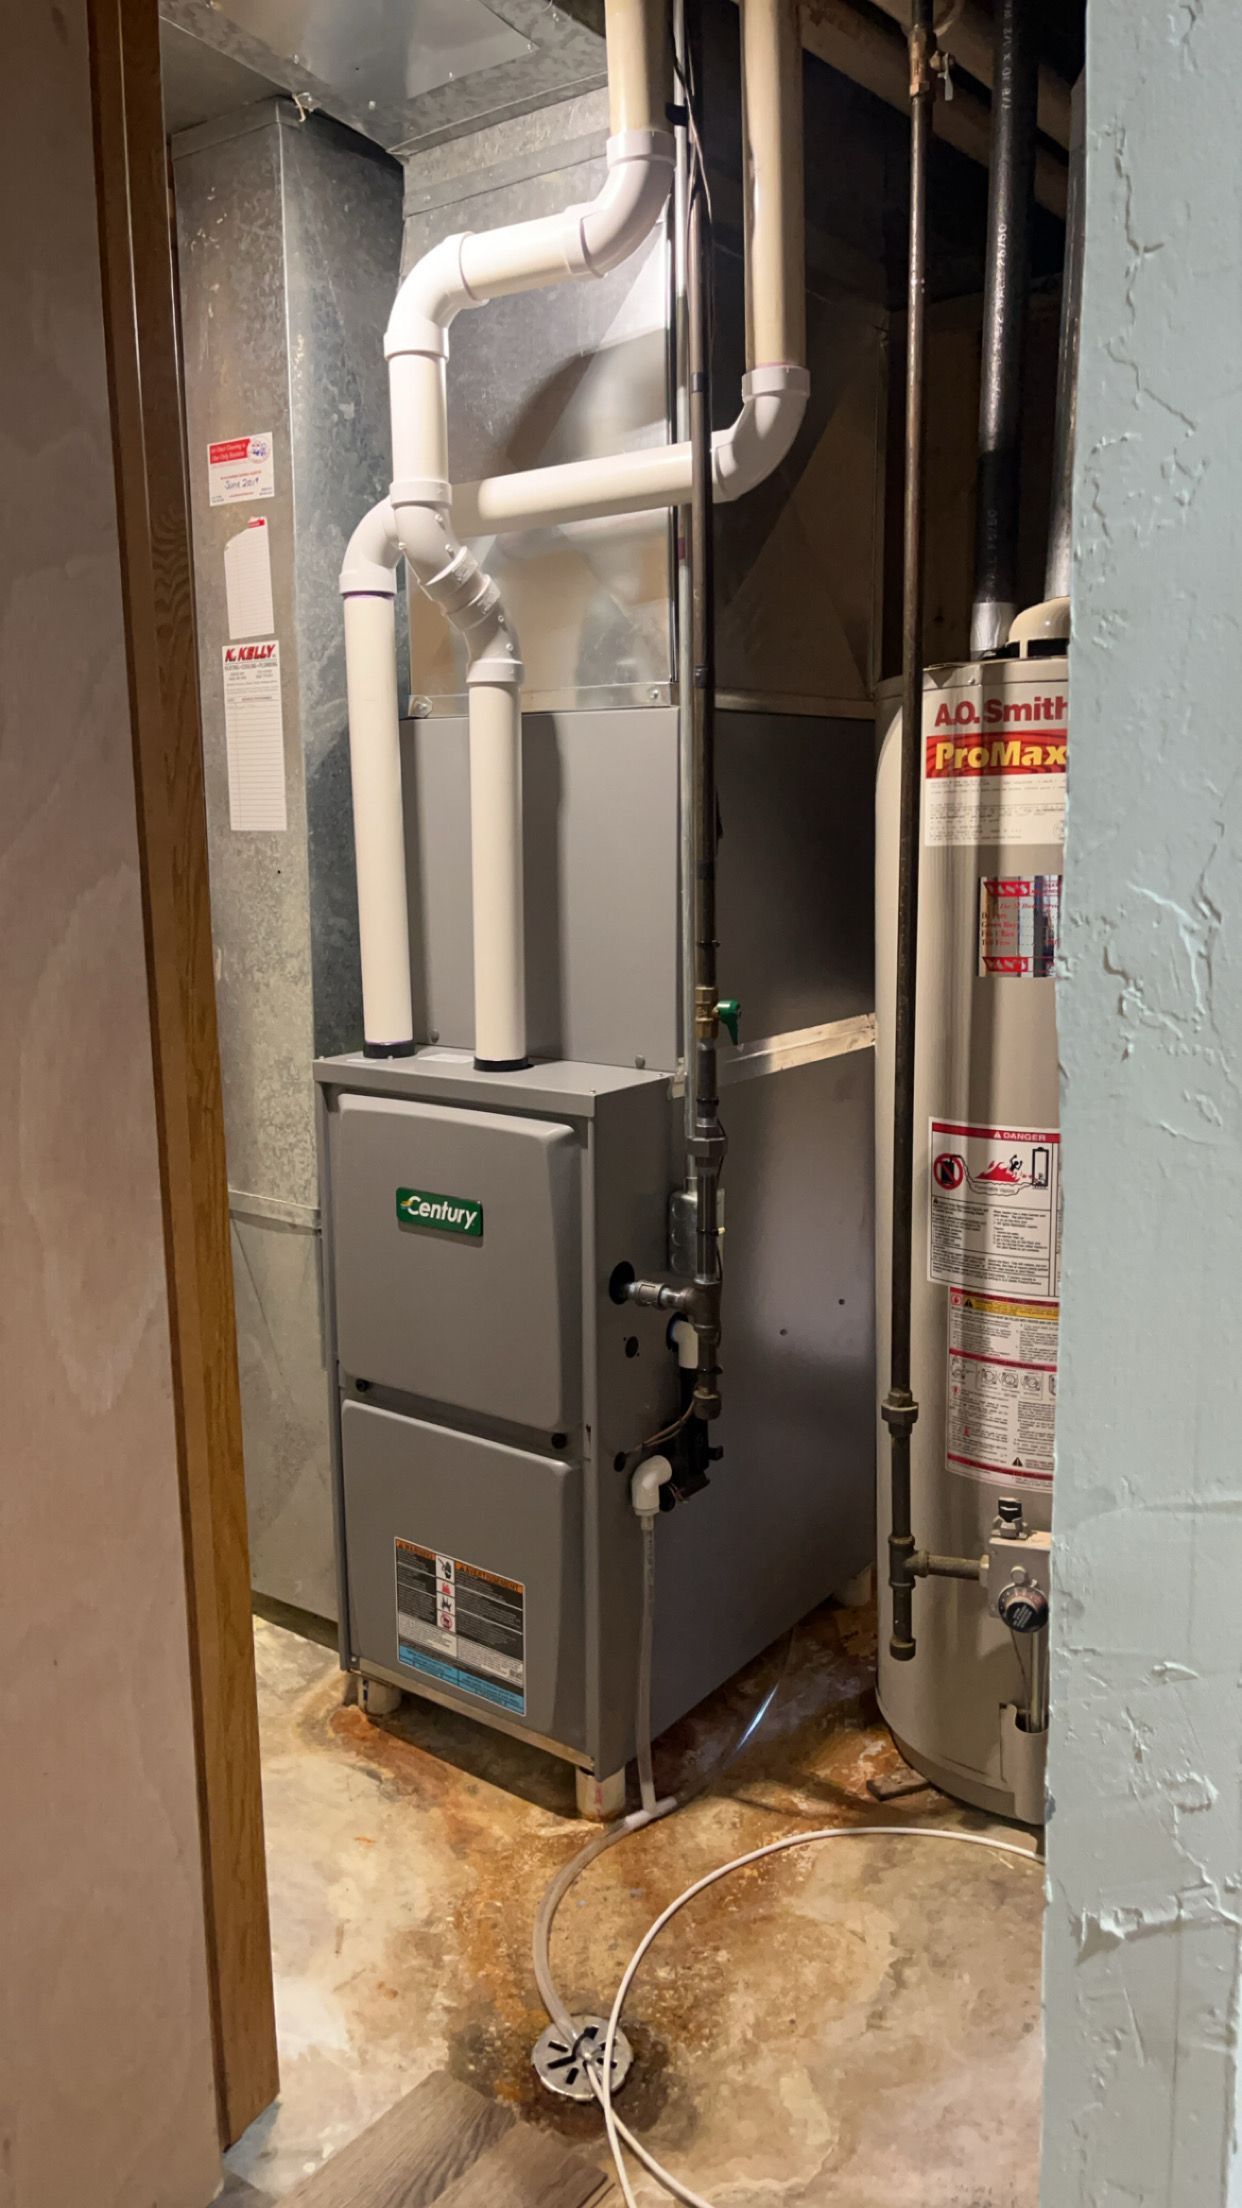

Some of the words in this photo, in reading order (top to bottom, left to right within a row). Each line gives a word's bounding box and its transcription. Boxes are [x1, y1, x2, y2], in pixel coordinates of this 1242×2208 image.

[238, 644, 276, 661] KELLY
[935, 701, 980, 727] A.O.
[935, 740, 1067, 770] ProMax
[1003, 1132, 1047, 1142] DANGER
[407, 1195, 478, 1230] Century
